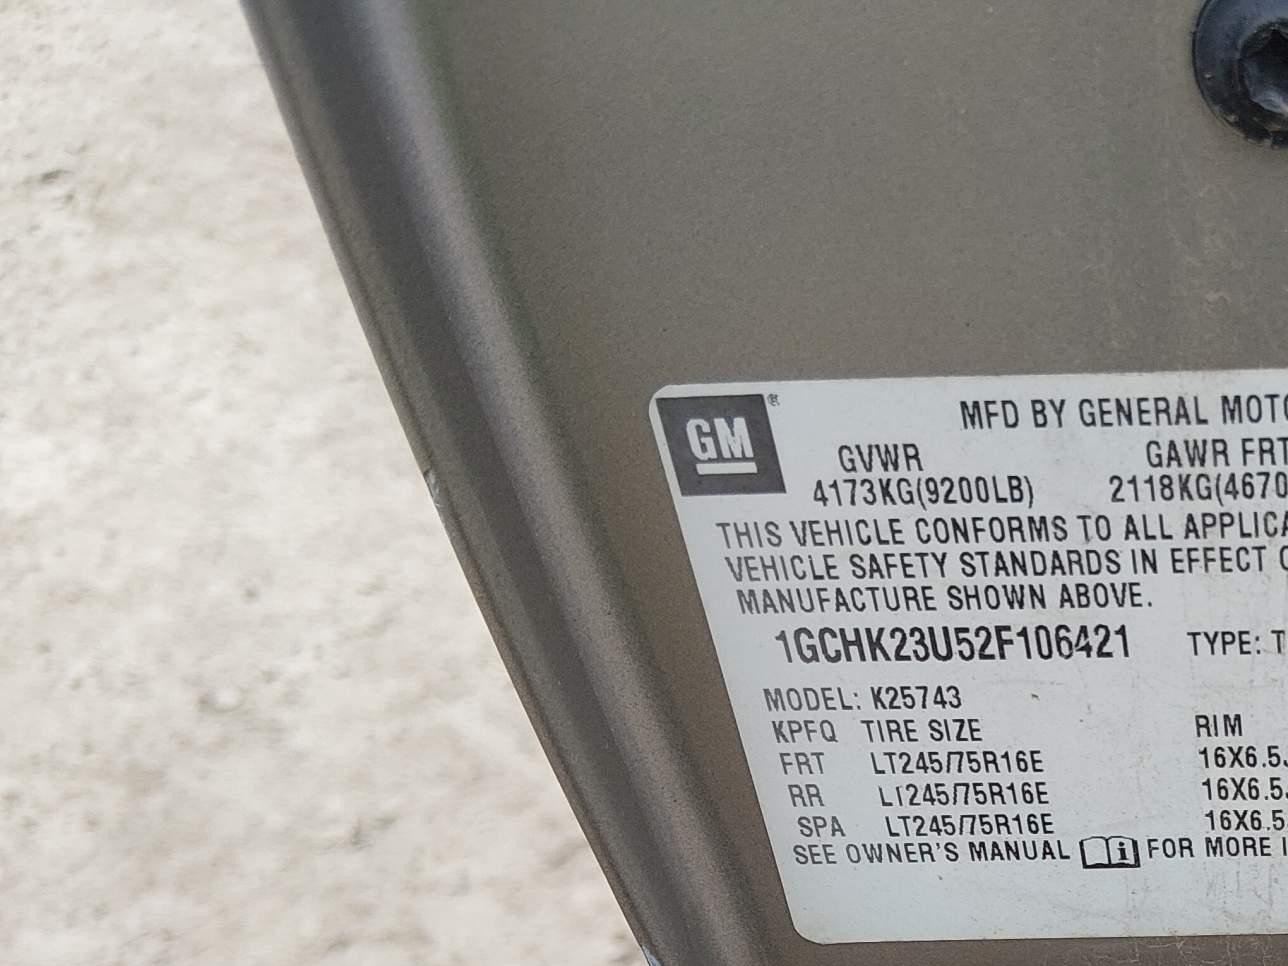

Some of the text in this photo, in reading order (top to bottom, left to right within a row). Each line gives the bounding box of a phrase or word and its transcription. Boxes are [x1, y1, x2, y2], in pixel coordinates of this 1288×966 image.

[960, 400, 1019, 429] MFD
[1031, 399, 1065, 428] BY
[1079, 396, 1208, 427] GENERAL
[687, 418, 753, 459] GM
[838, 444, 923, 473] GVWR
[1146, 439, 1230, 468] GAWR
[814, 476, 1033, 510] 4173KG(9200LB)
[716, 521, 782, 548] THIS
[791, 519, 904, 546] VEHICLE
[915, 516, 1067, 544] CONFORMS
[1077, 515, 1111, 542] TO
[1125, 514, 1173, 540] ALL
[726, 554, 839, 582] VEHICLE
[849, 552, 947, 579] SAFETY
[960, 549, 1120, 577] STANDARDS
[1131, 549, 1157, 574] IN
[1171, 546, 1266, 573] EFFECT
[737, 582, 1152, 614] MANUFACTURE SHOWN ABOVE.
[776, 624, 1129, 663] 1GCHK23U52F106421
[1187, 631, 1260, 656] TYPE:
[763, 686, 961, 712] MODEL: K25743
[772, 720, 838, 743] KPFQ
[861, 719, 982, 742] TIRE SIZE
[1195, 714, 1242, 737] RIM
[779, 752, 824, 775] FRT
[871, 751, 1043, 774] LT245/75R16E
[788, 784, 824, 807] RR
[798, 816, 845, 837] SPA
[885, 813, 1054, 837] LT245/75R16E
[793, 844, 837, 864] SEE
[846, 842, 959, 863] OWNER'S
[969, 840, 1070, 861] MANUAL
[1147, 838, 1194, 858] FOR
[1205, 837, 1271, 857] MORE
